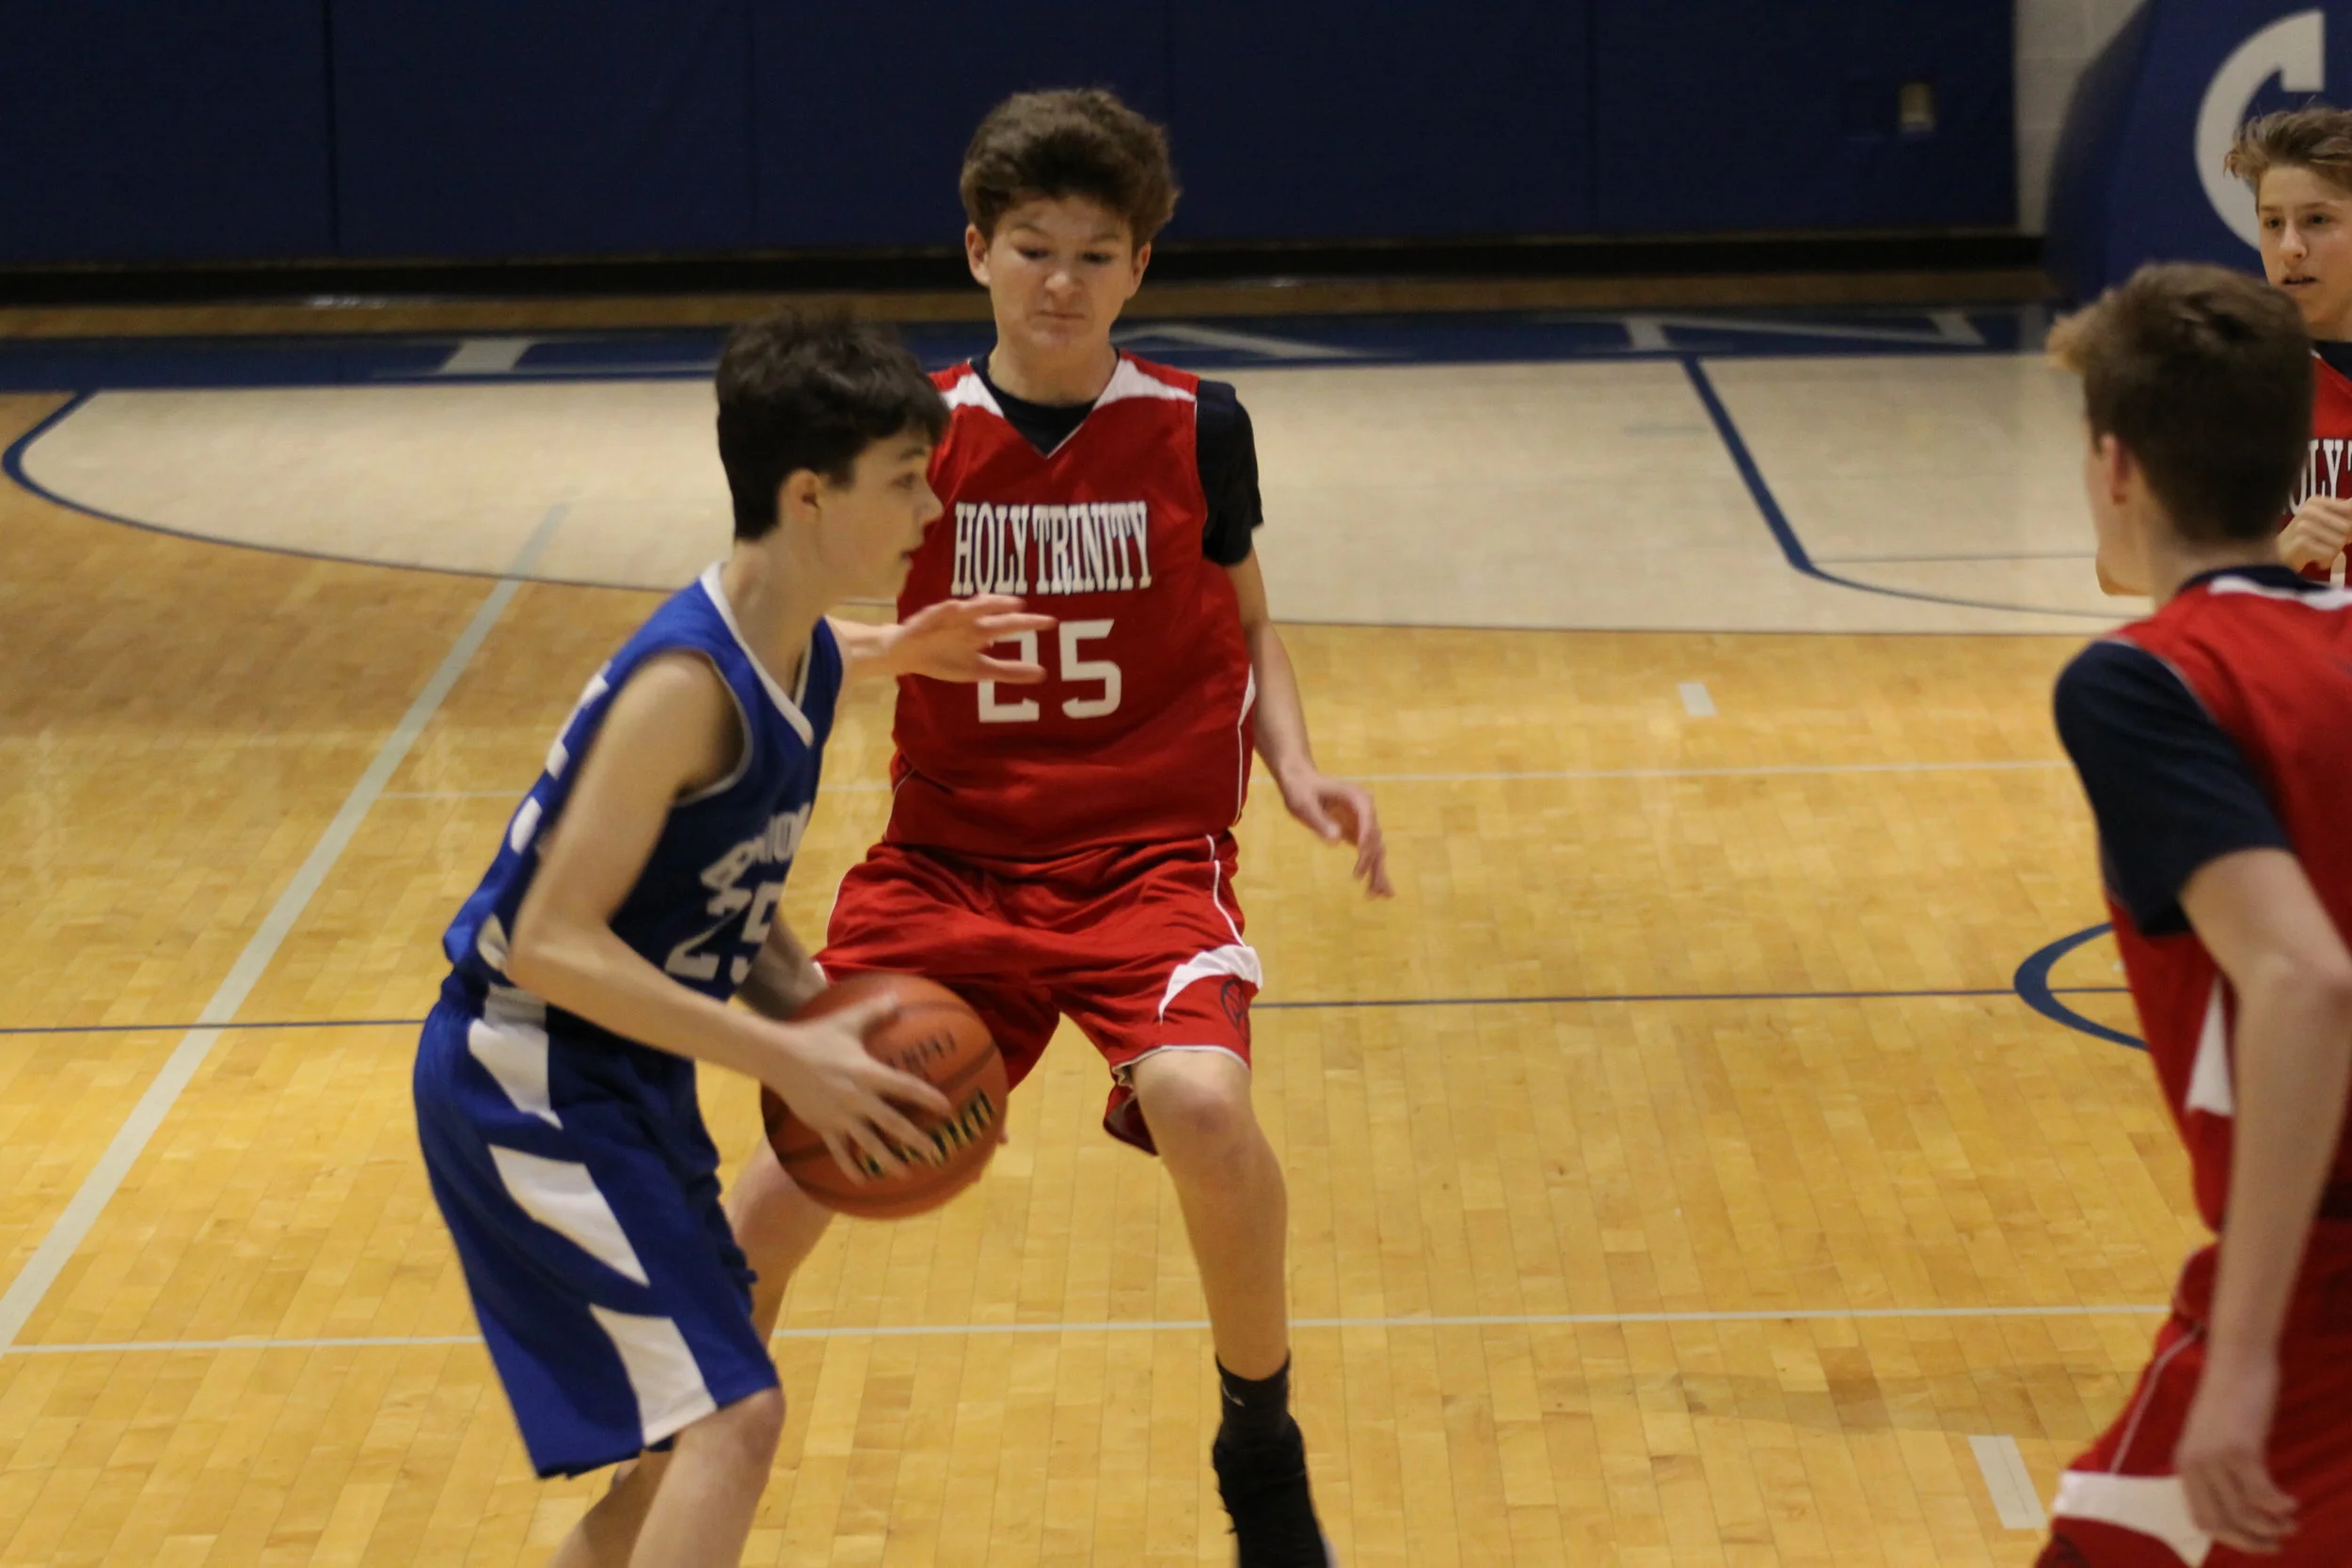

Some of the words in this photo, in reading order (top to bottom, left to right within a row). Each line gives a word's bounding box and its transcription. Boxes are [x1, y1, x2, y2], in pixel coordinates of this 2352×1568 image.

[950, 501, 1030, 596] HOLY
[1032, 500, 1152, 596] TRINITY
[977, 618, 1122, 723] 25
